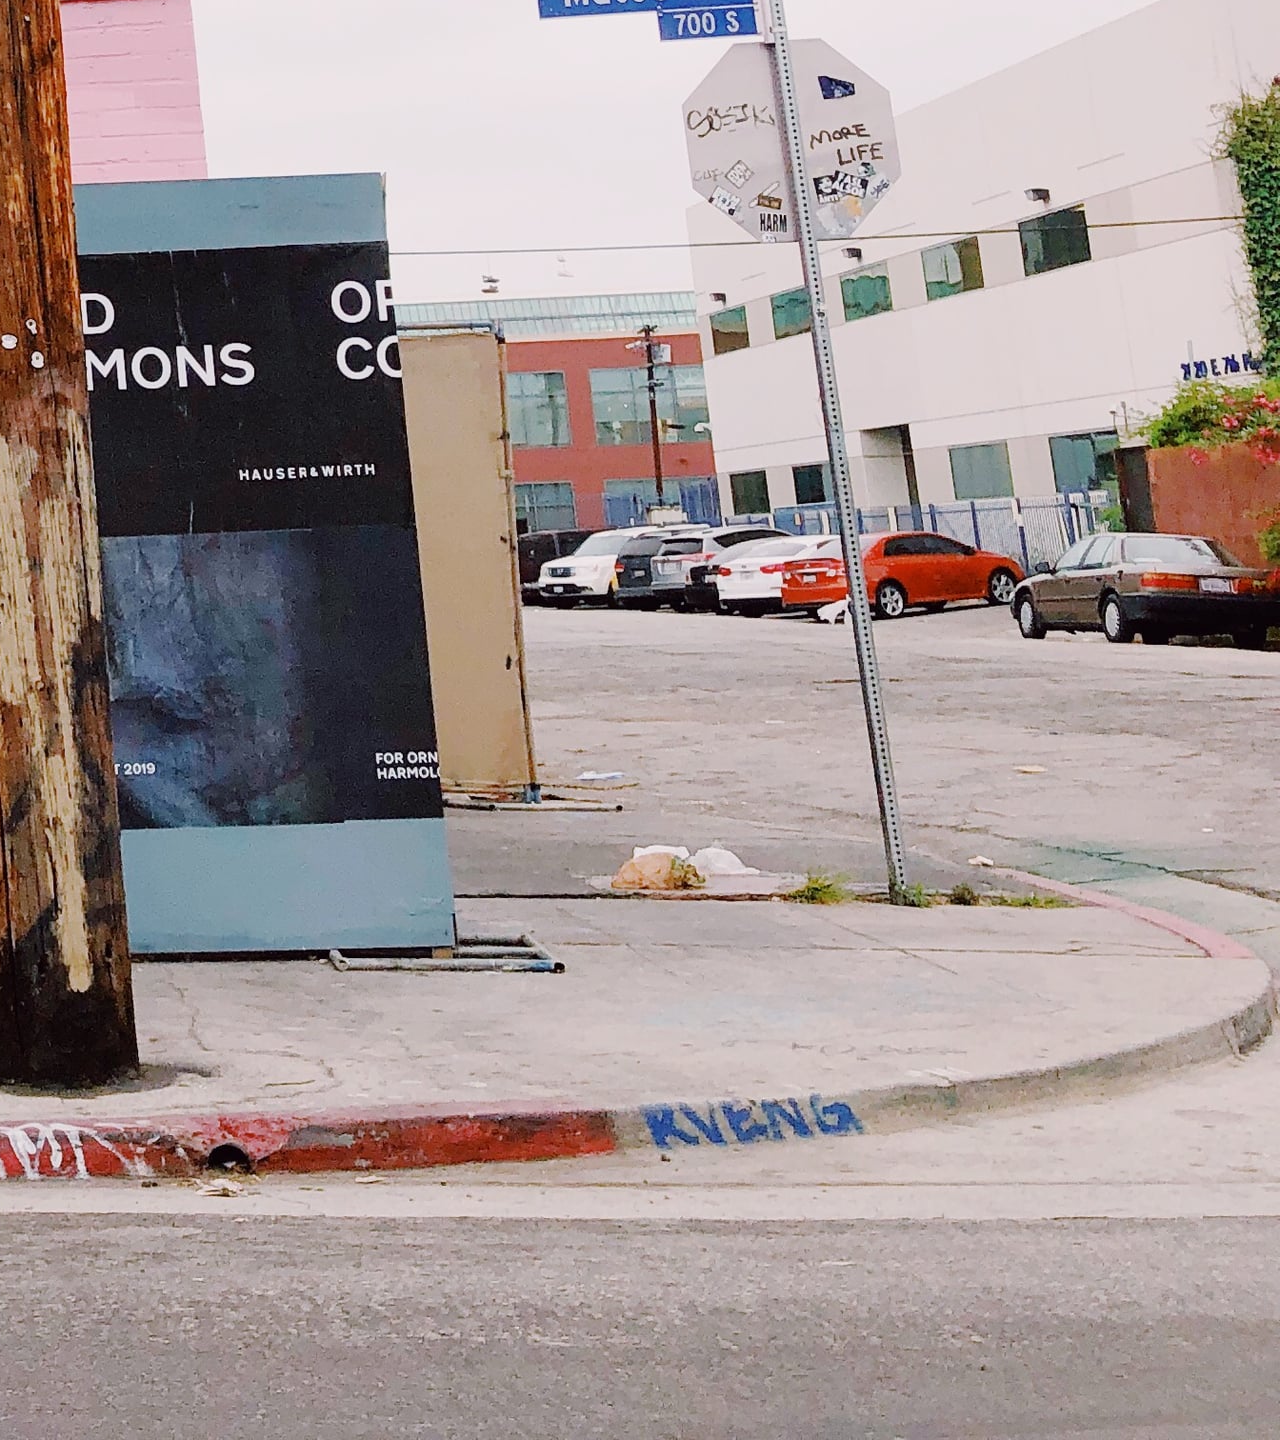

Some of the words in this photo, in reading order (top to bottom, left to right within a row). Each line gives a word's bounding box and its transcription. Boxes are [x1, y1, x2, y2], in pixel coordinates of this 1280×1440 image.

[672, 13, 716, 36] 700
[725, 10, 740, 33] S
[810, 124, 871, 150] MORE
[837, 142, 883, 166] LIFE
[760, 213, 787, 232] HARM
[85, 342, 255, 391] MONS
[239, 463, 376, 481] HAUSER&WIRTH
[124, 762, 156, 775] 2019
[375, 752, 403, 765] FOR
